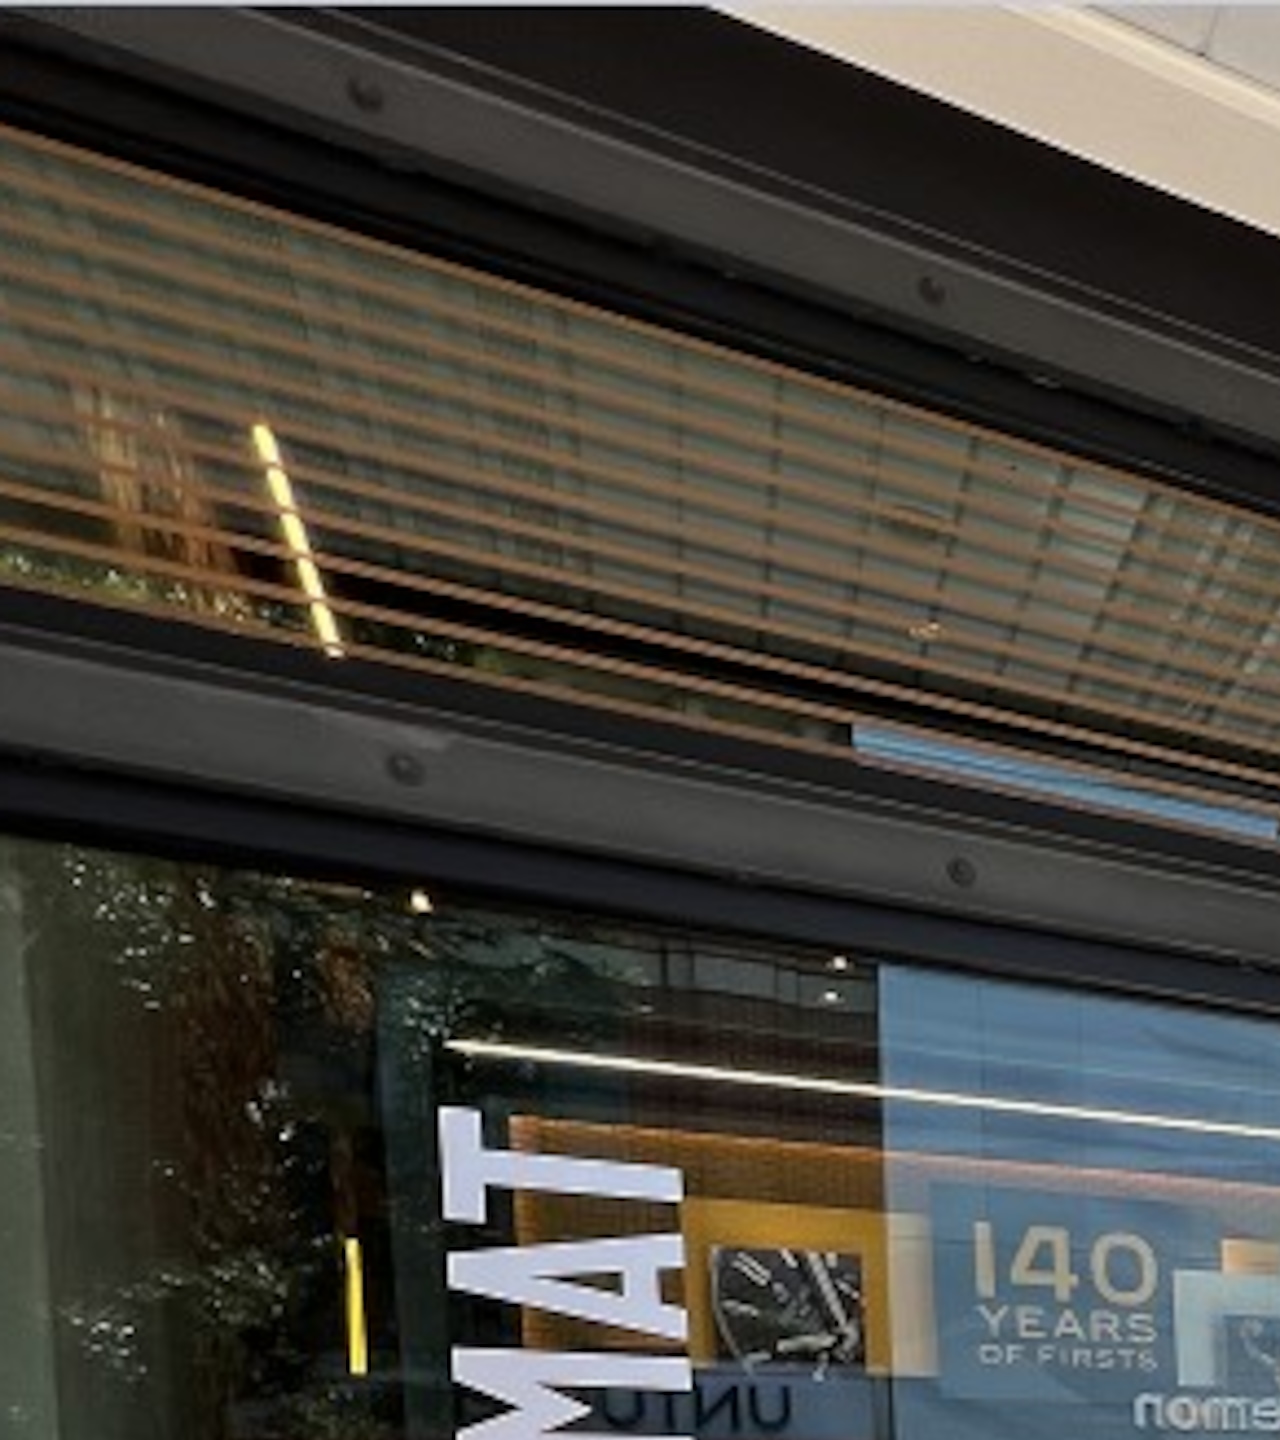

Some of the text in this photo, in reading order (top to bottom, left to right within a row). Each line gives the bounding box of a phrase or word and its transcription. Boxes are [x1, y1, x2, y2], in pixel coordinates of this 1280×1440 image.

[974, 1221, 1159, 1307] 140
[976, 1304, 1158, 1345] YEARS
[979, 1344, 1159, 1373] OF FIRSTS
